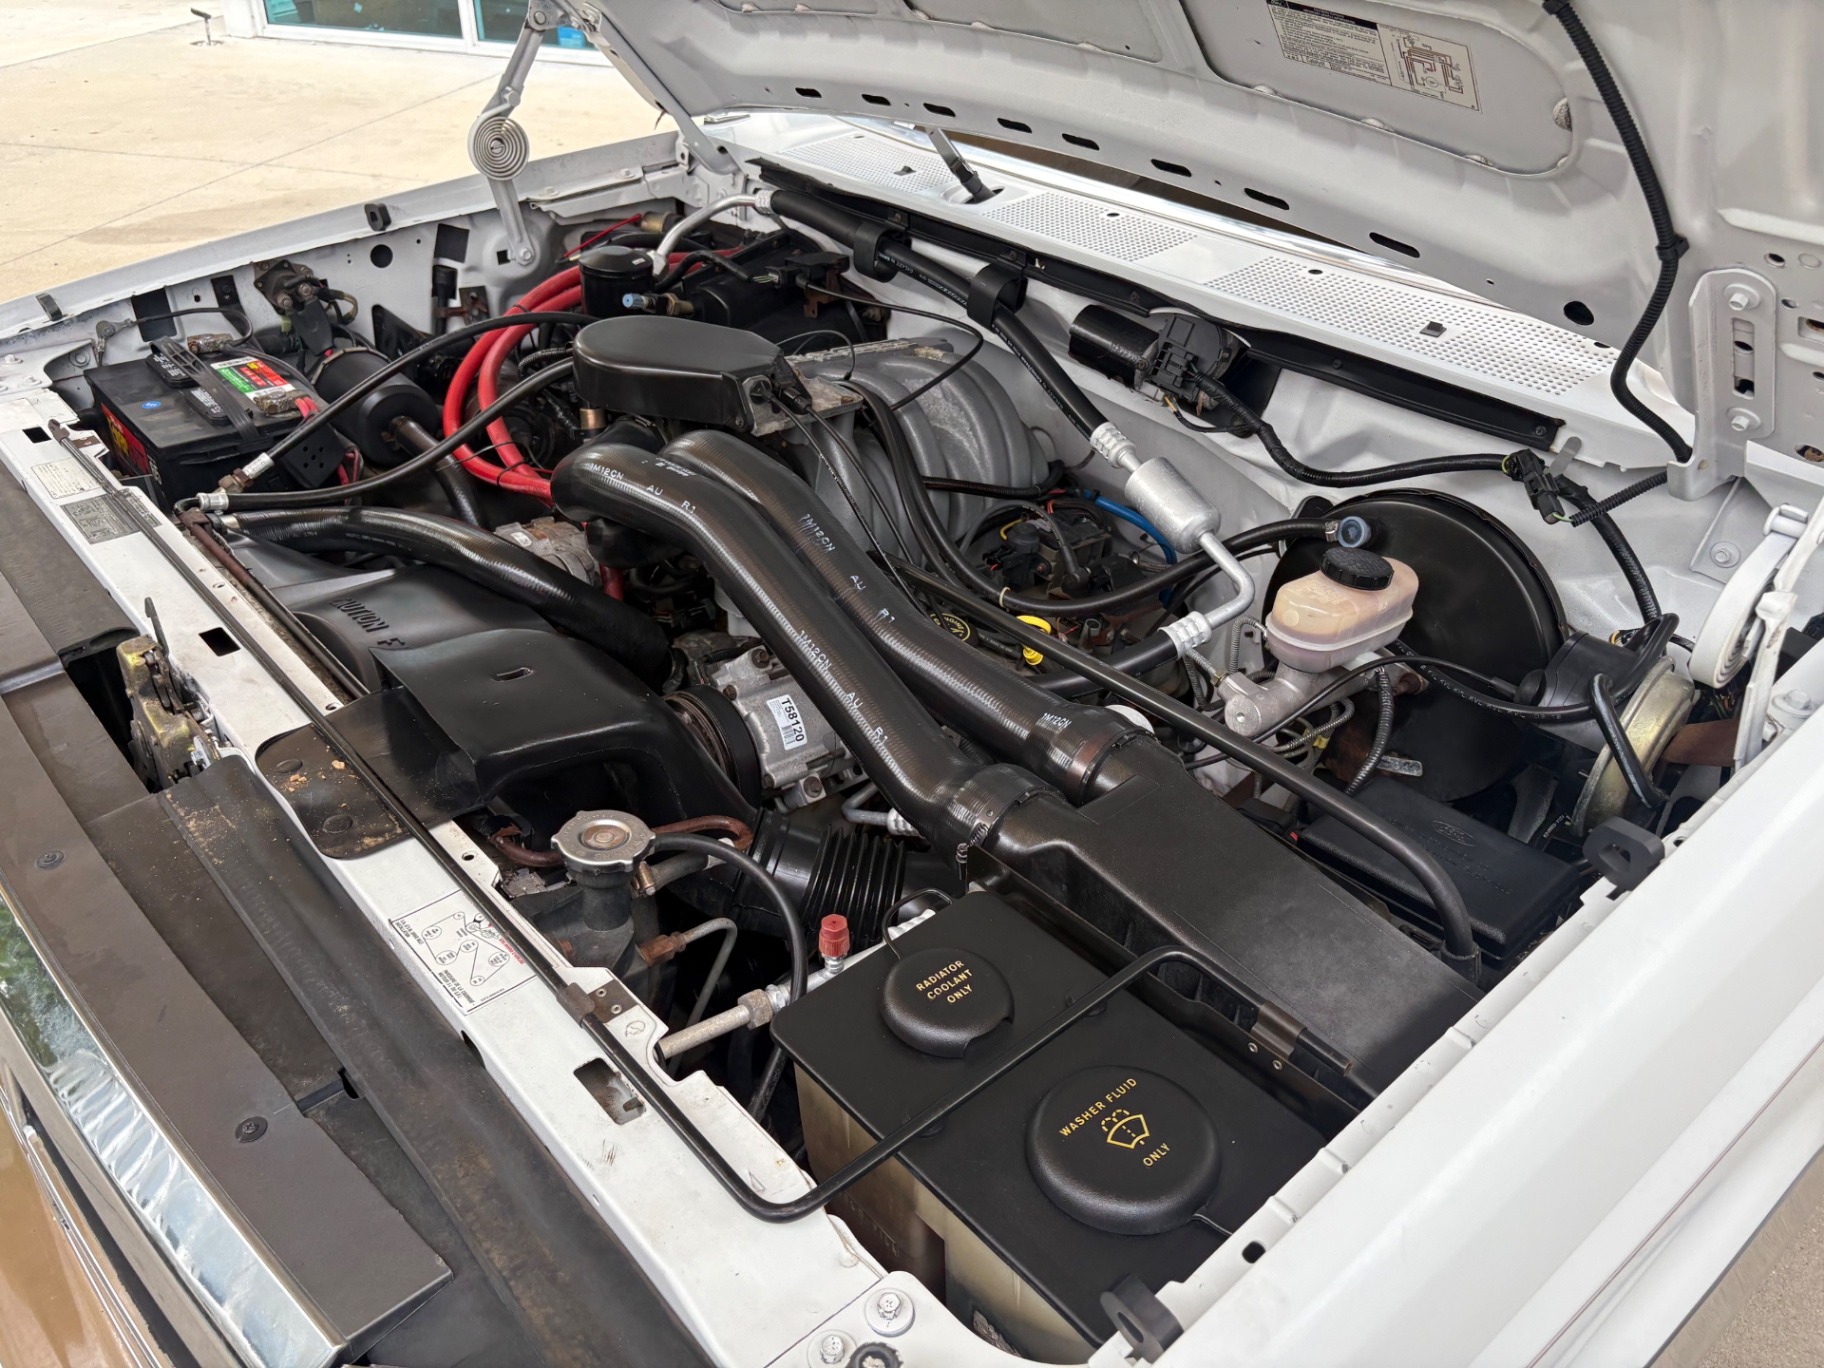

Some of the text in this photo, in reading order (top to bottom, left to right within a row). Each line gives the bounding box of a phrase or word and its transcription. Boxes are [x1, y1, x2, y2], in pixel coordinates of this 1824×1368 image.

[646, 484, 663, 496] AU
[681, 500, 696, 514] R1
[846, 692, 864, 708] AU
[781, 698, 805, 742] T58120
[916, 960, 965, 991] RADIATOR
[927, 969, 973, 1000] COOLANT
[946, 984, 973, 1004] ONLY
[1059, 1078, 1137, 1137] WASHER FLUID
[1143, 1142, 1171, 1167] ONLY
